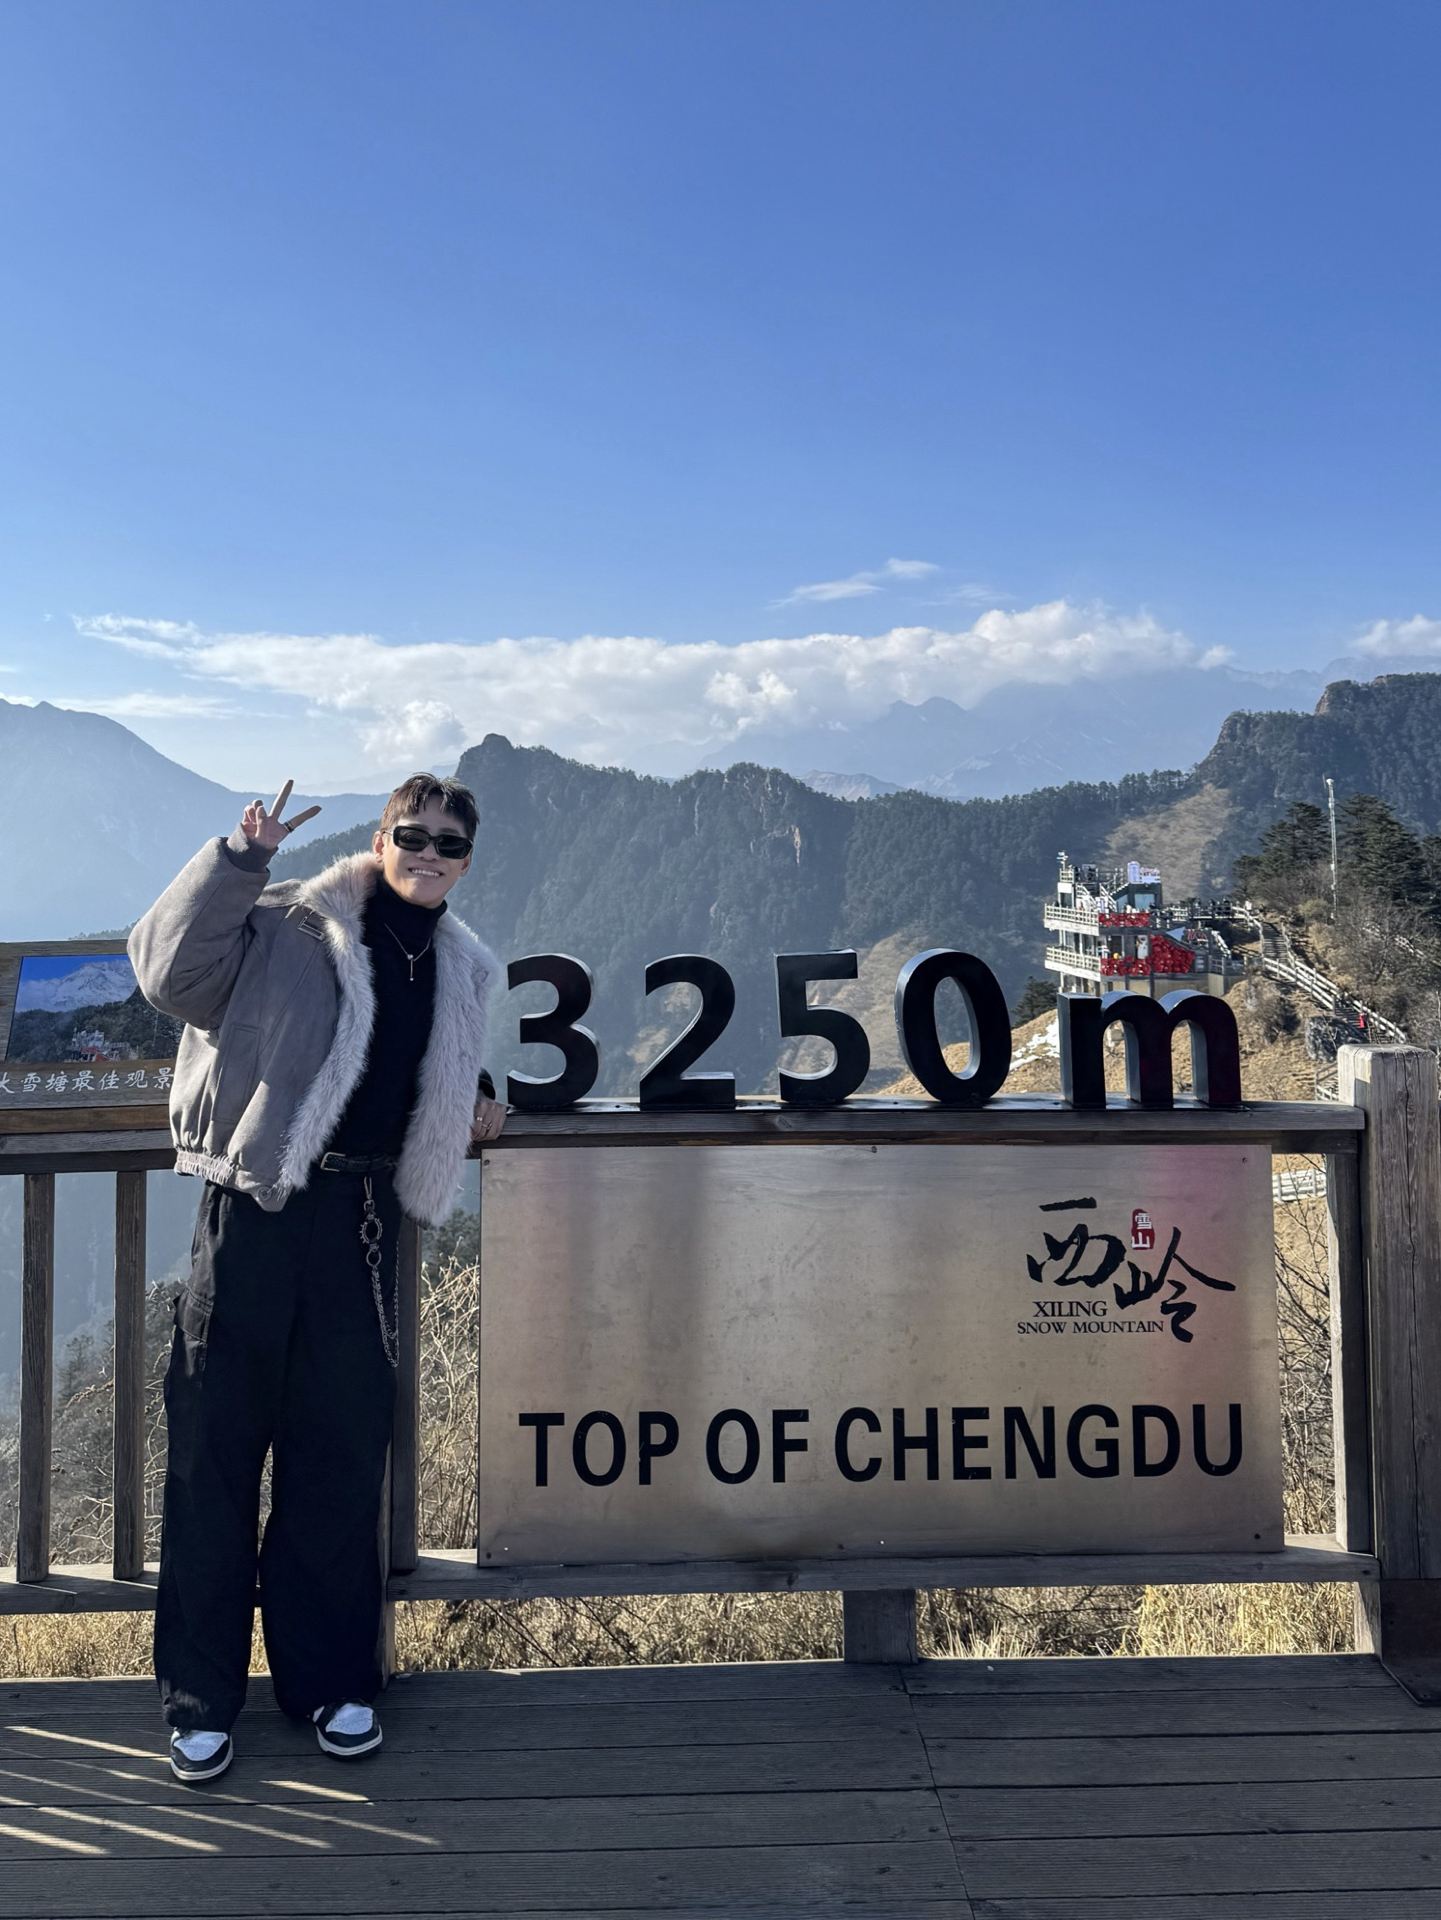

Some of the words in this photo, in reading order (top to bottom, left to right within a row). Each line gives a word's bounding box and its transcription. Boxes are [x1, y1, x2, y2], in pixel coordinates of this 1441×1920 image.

[1033, 1300, 1108, 1318] XILING
[1017, 1321, 1067, 1335] SNOW
[1072, 1320, 1164, 1334] MOUNTAIN
[519, 1409, 680, 1488] TOP
[706, 1407, 810, 1485] OF
[834, 1402, 1243, 1483] CHENGDU
